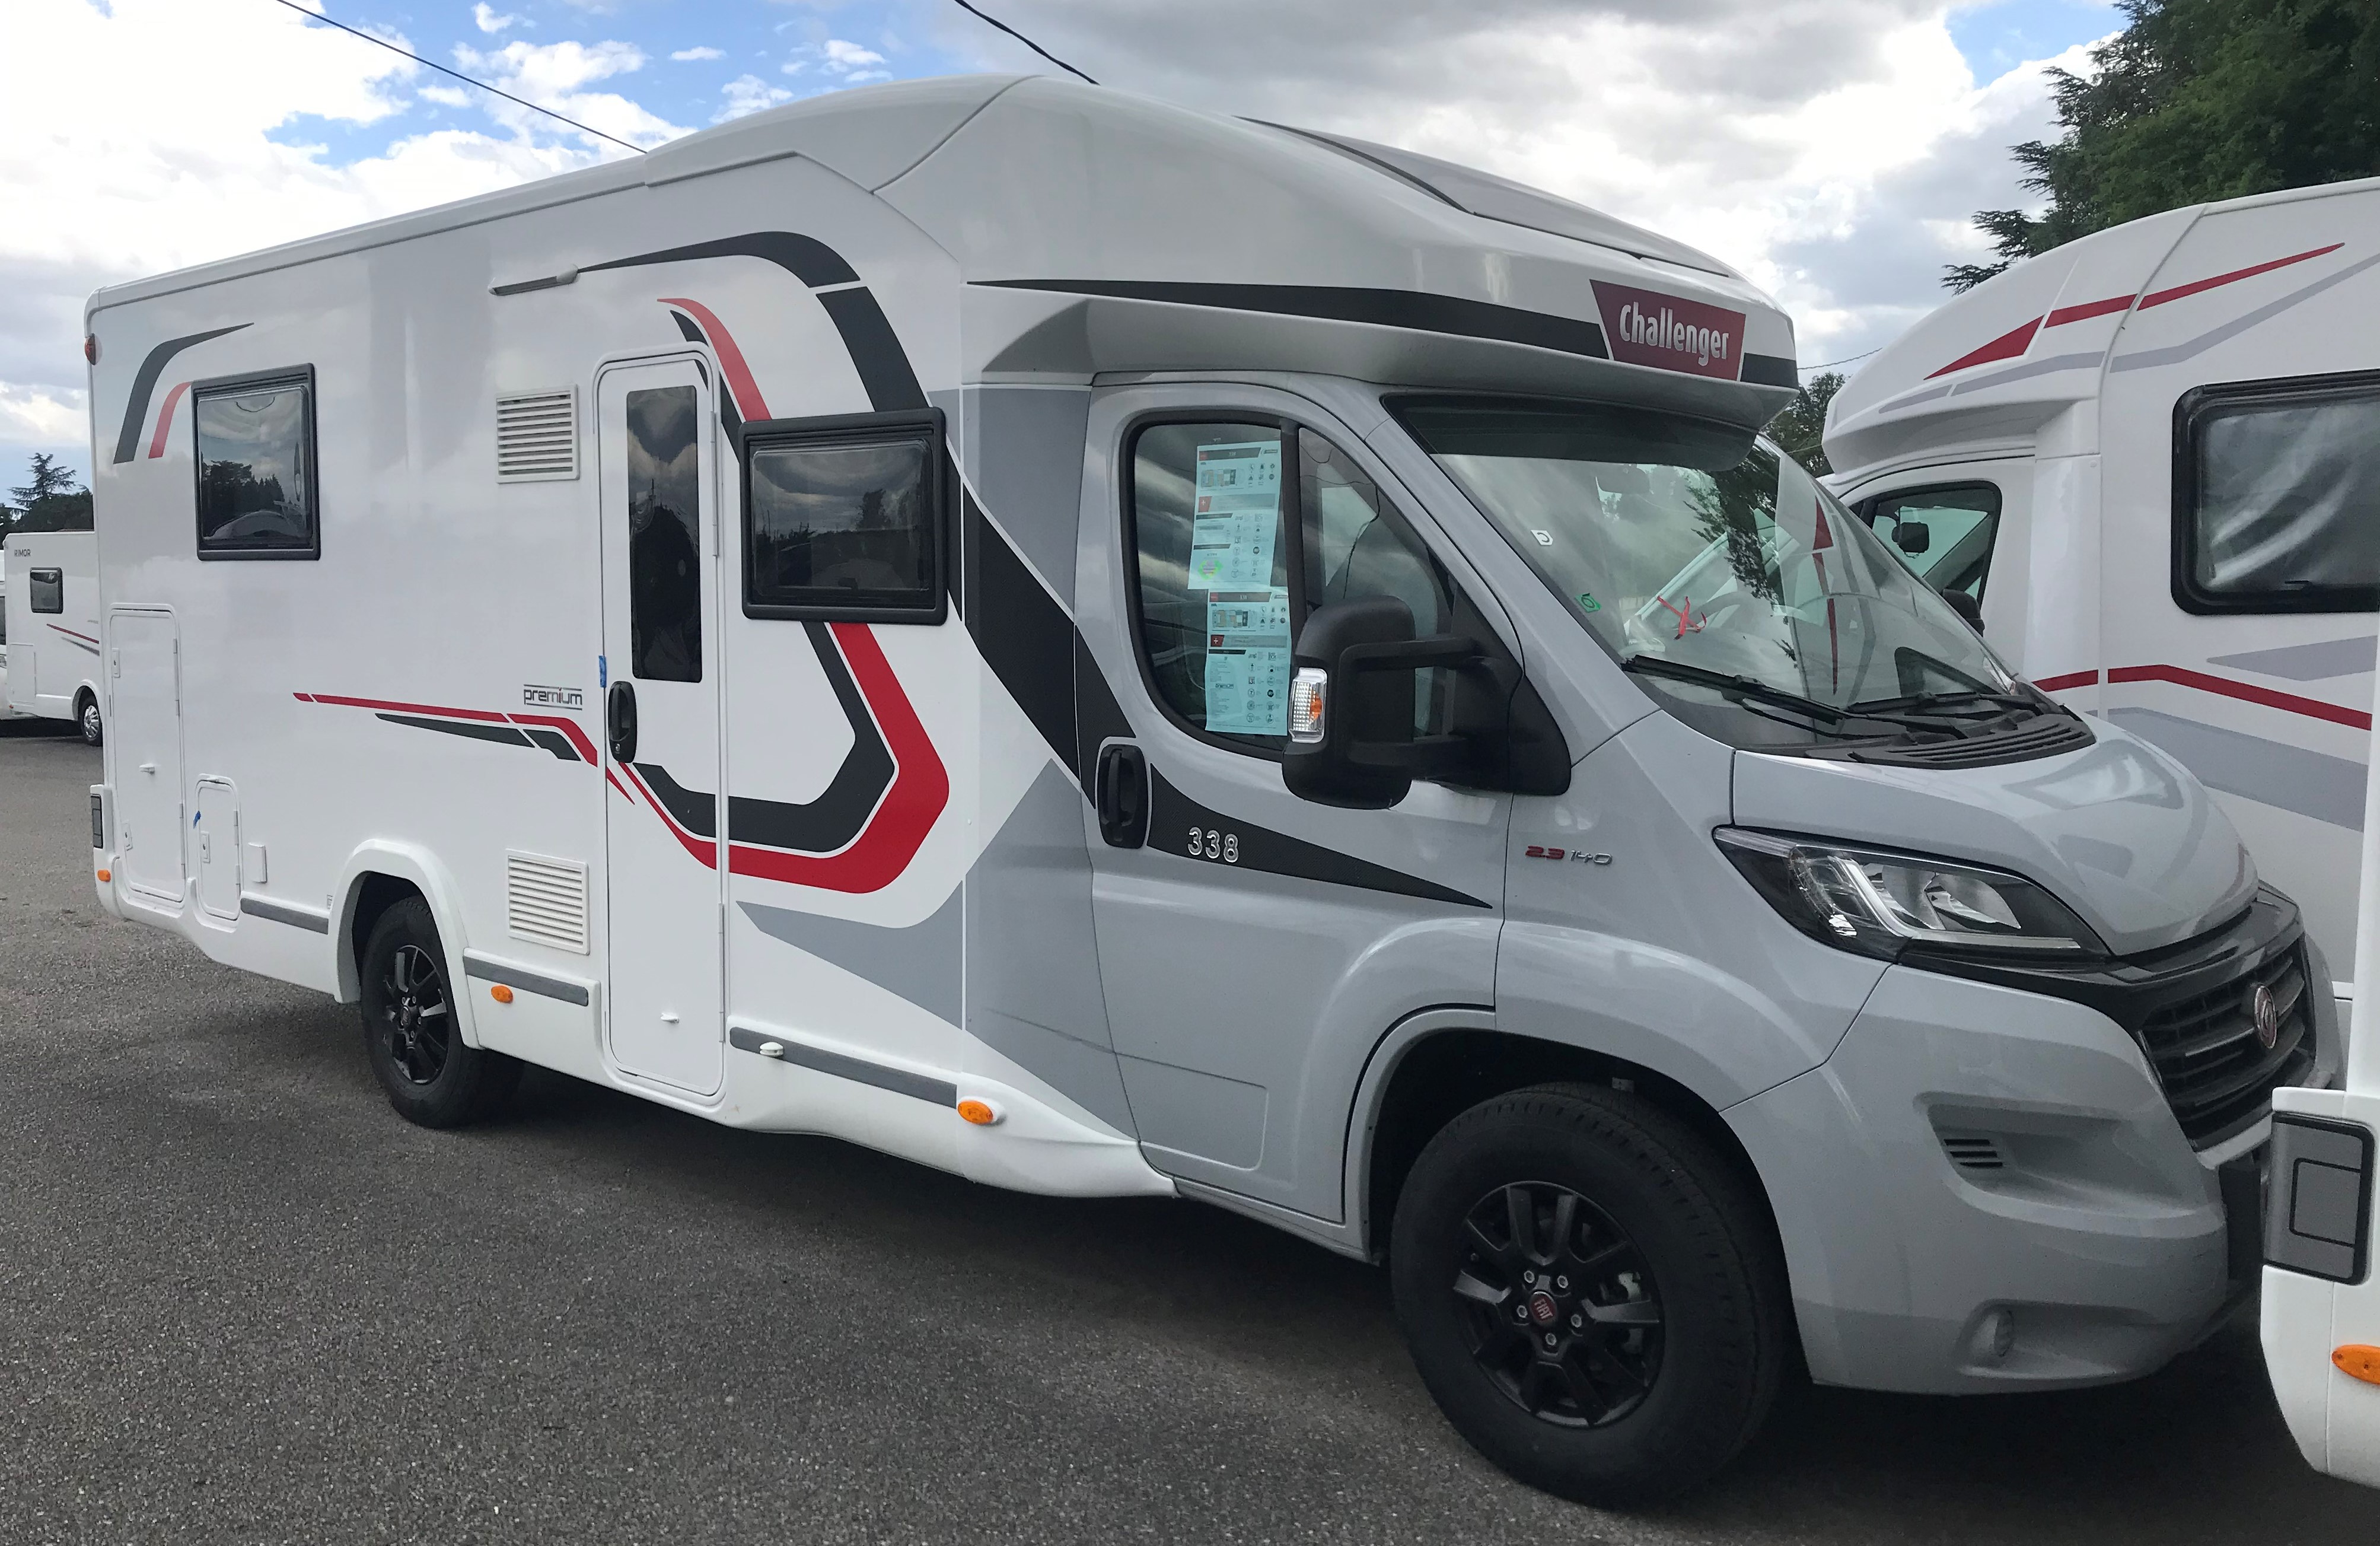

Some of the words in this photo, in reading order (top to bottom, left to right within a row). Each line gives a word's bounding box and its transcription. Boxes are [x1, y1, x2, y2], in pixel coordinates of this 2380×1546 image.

[1620, 301, 1729, 367] Challenger
[524, 687, 582, 705] premium
[1188, 827, 1239, 863] 338
[1534, 1299, 1553, 1319] FIAT
